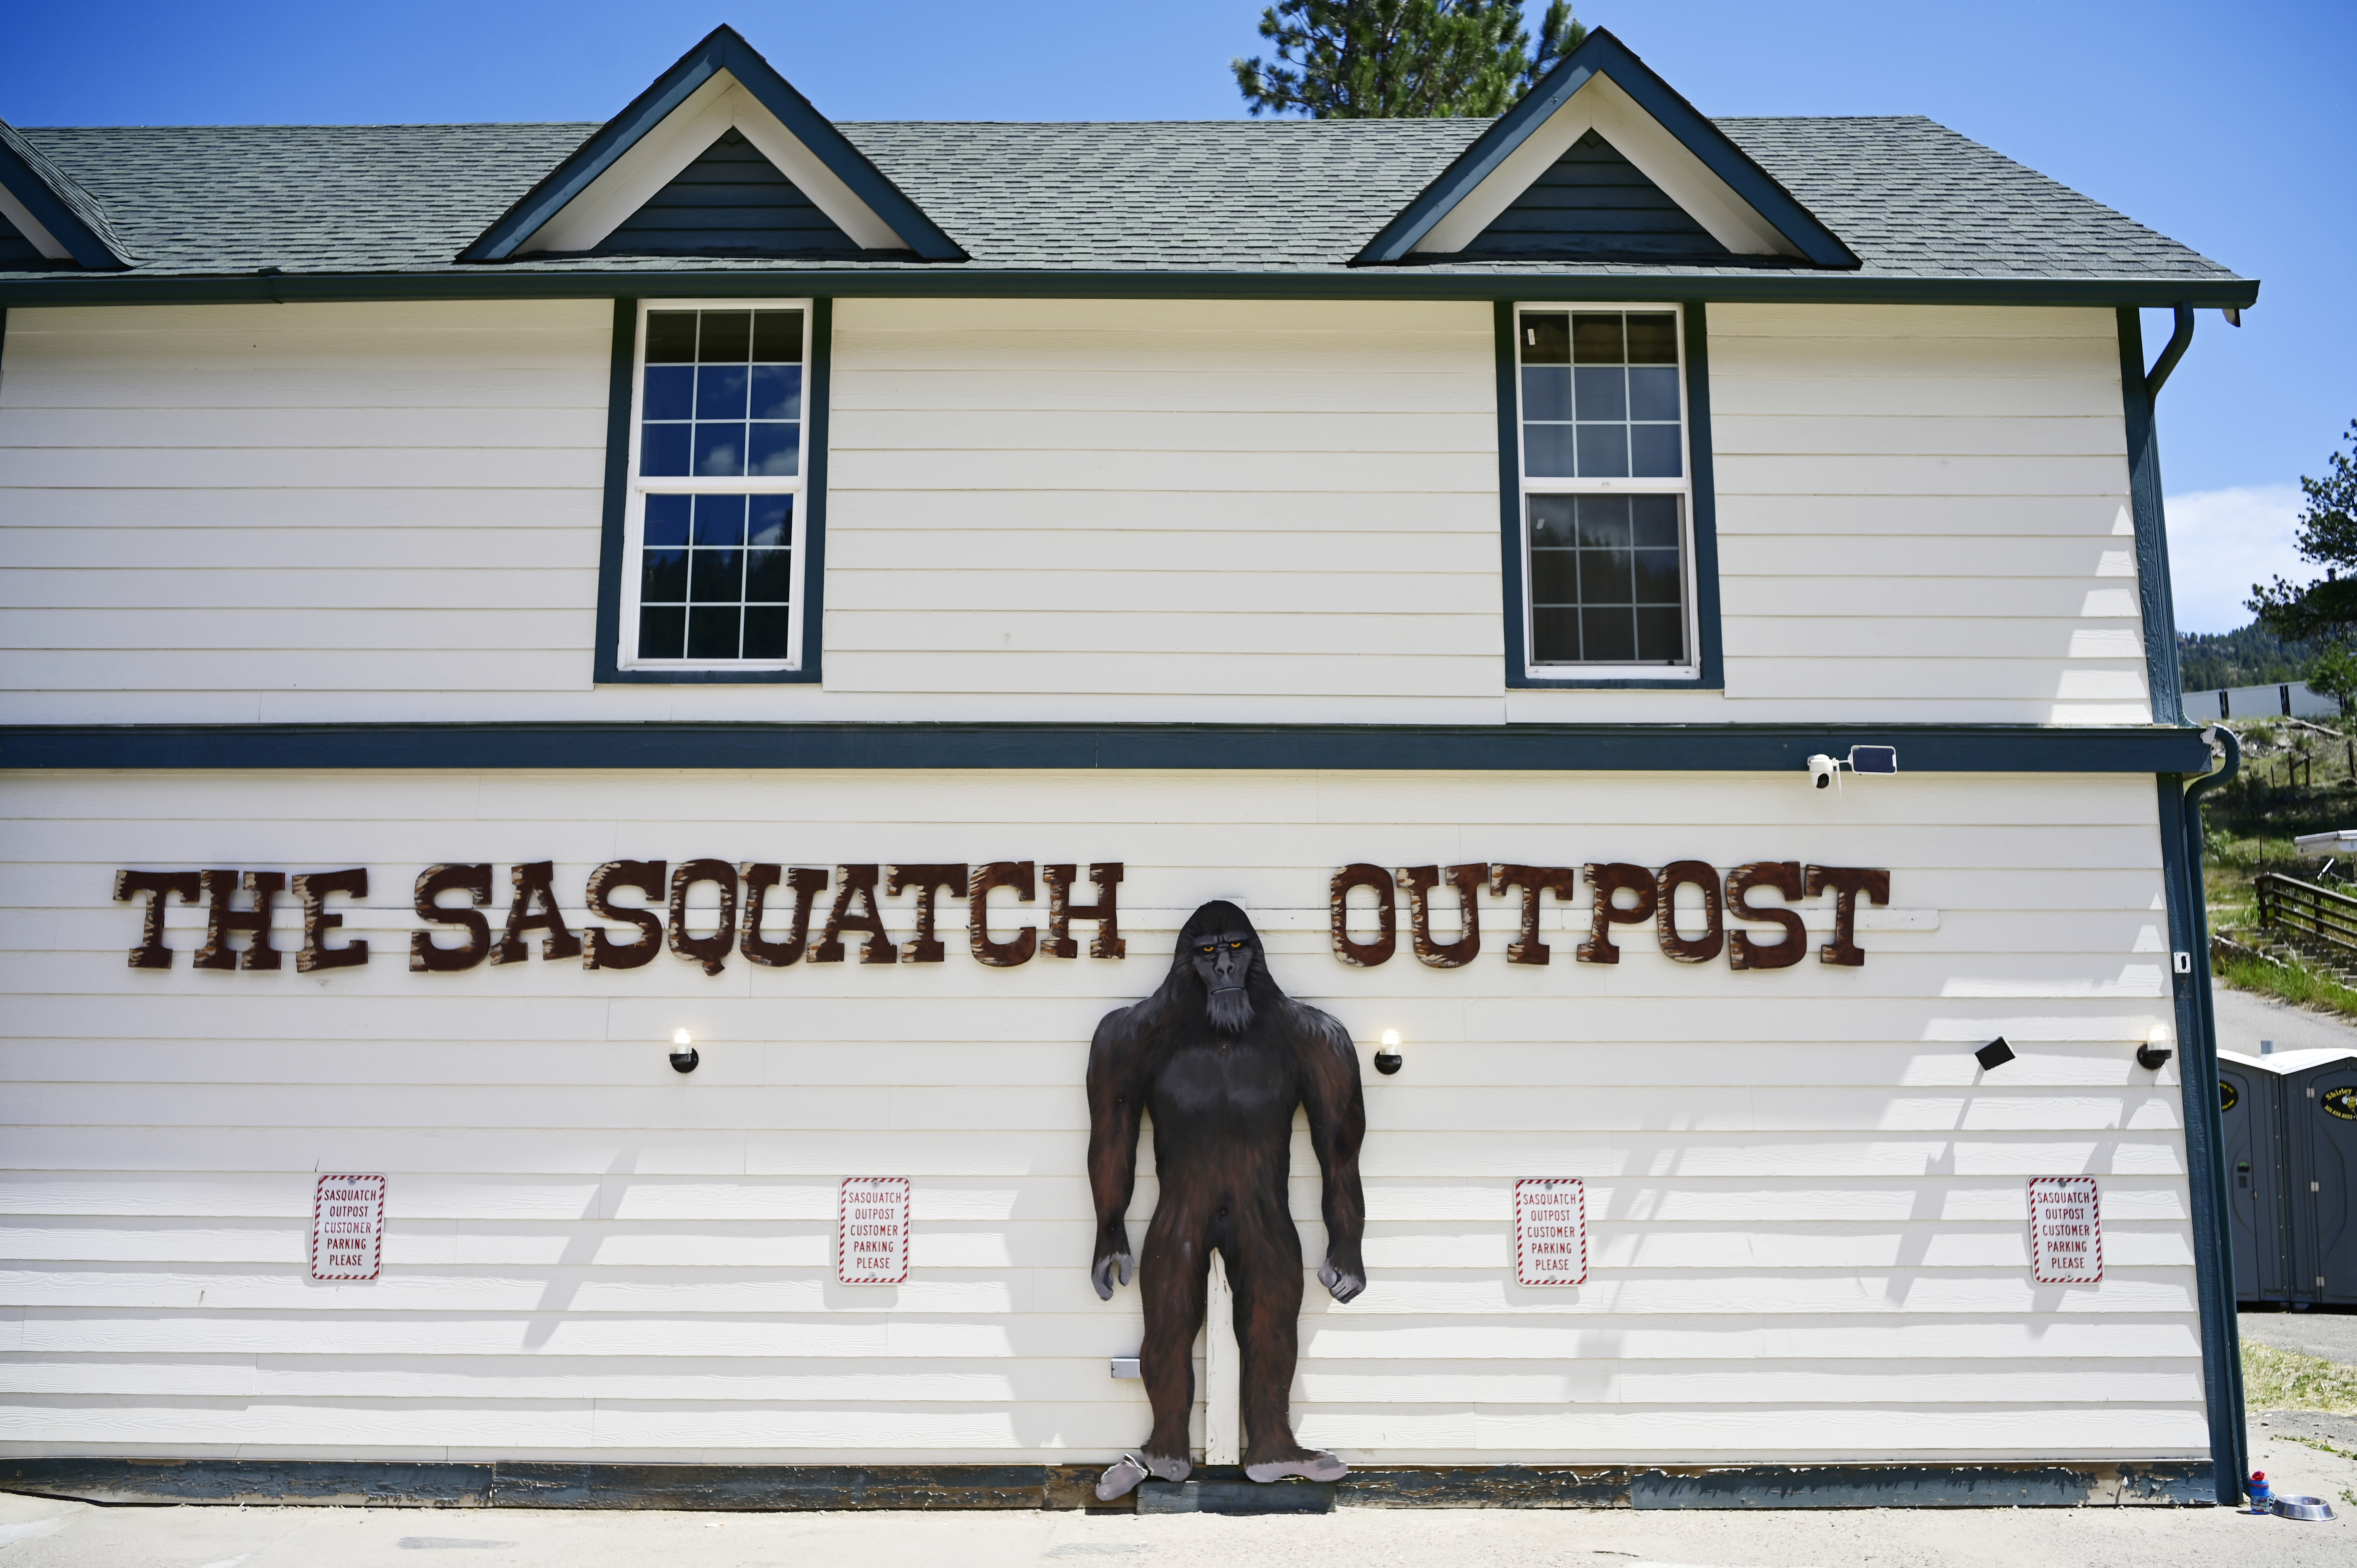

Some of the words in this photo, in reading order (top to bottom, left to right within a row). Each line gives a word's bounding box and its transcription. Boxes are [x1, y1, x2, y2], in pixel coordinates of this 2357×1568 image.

[113, 868, 368, 972] THE
[409, 859, 1126, 976] SASQUATCH
[1331, 860, 1890, 970] OUTPOST
[2326, 1088, 2352, 1101] Shirley
[324, 1189, 376, 1201] SASQUATCH
[849, 1193, 901, 1203] SASQUATCH
[1524, 1194, 1576, 1205] SASQUATCH
[2037, 1192, 2090, 1204] SASQUATCH
[330, 1206, 369, 1217] OUTPOST
[856, 1209, 894, 1219] OUTPOST
[1531, 1210, 1570, 1221] OUTPOST
[2046, 1208, 2084, 1220] OUTPOST
[325, 1222, 371, 1233] CUSTOMER
[851, 1225, 898, 1236] CUSTOMER
[1528, 1227, 1575, 1237] CUSTOMER
[2043, 1225, 2090, 1236] CUSTOMER
[327, 1239, 366, 1249] PARKING
[854, 1241, 893, 1252] PARKING
[1532, 1243, 1571, 1254] PARKING
[2048, 1241, 2087, 1252] PARKING
[330, 1255, 362, 1266] PLEASE
[857, 1258, 890, 1268] PLEASE
[1536, 1260, 1569, 1270] PLEASE
[2052, 1258, 2085, 1268] PLEASE
